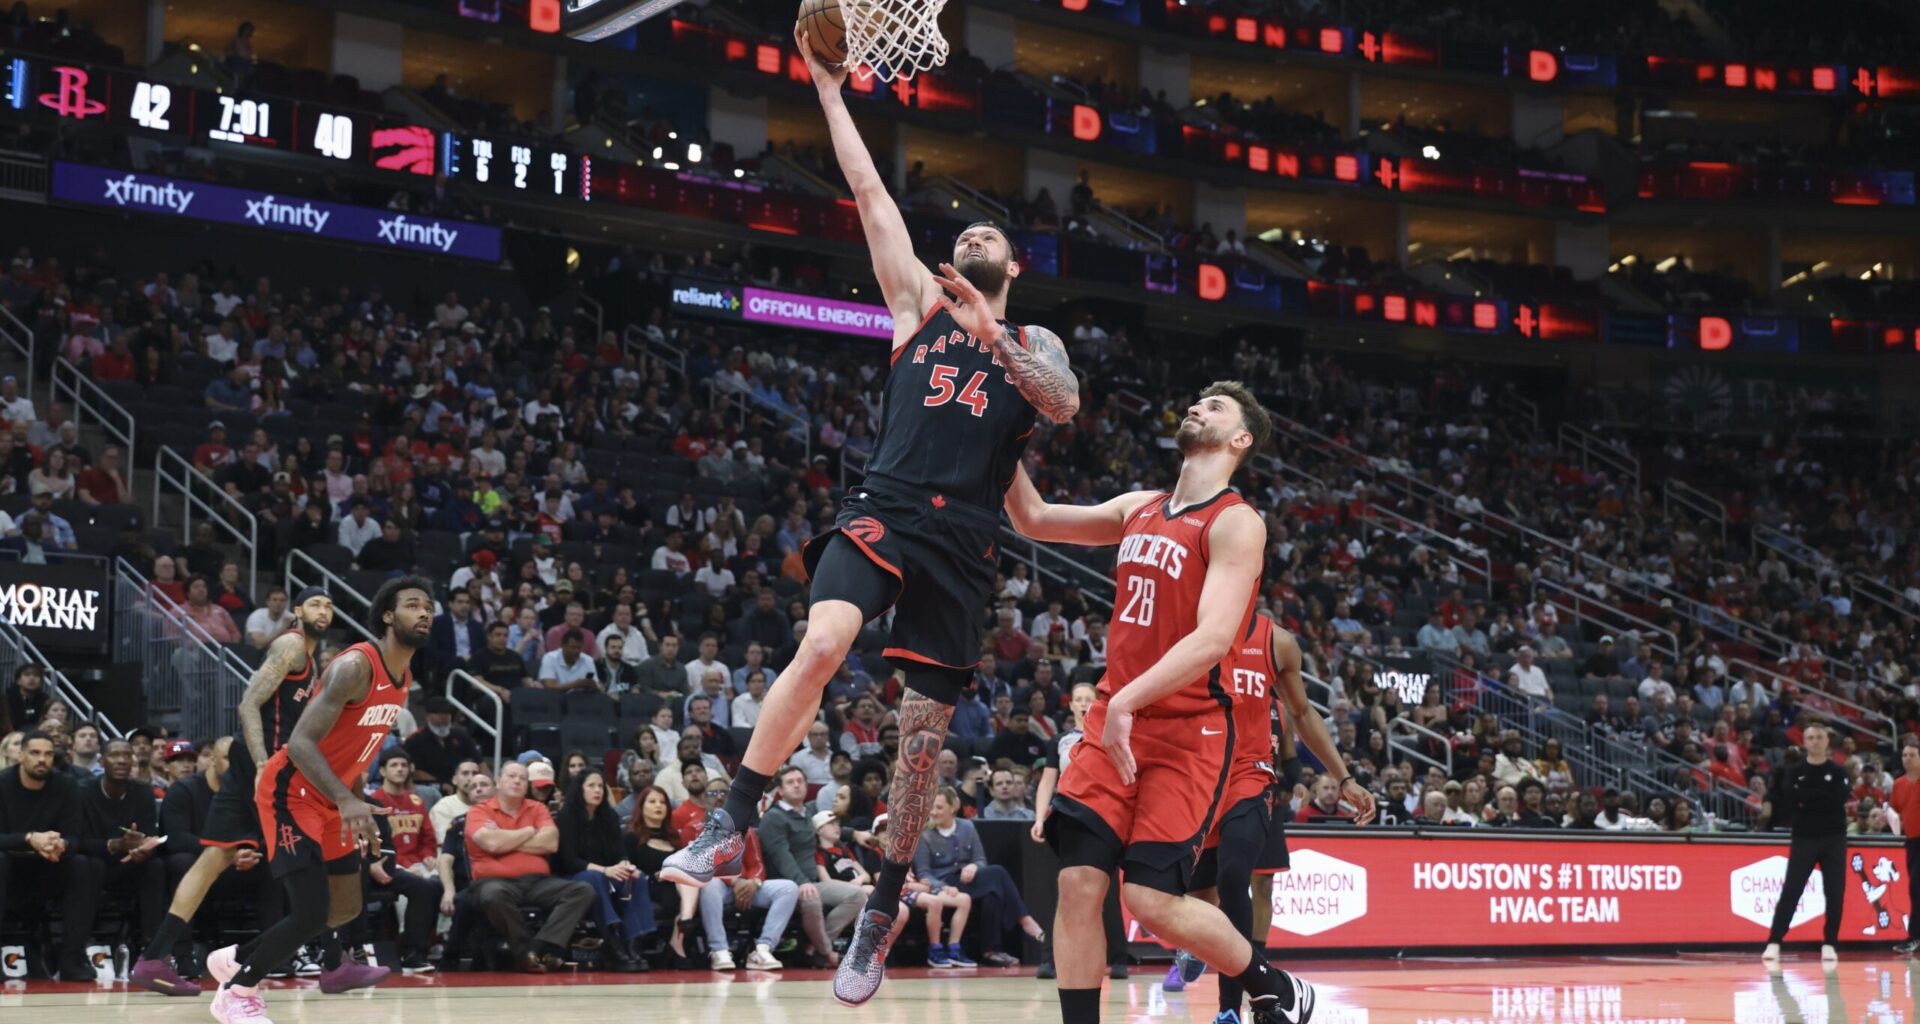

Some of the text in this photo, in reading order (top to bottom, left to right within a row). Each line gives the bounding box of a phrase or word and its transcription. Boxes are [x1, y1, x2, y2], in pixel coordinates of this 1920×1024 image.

[1529, 50, 1557, 81] D
[130, 81, 171, 130] 42
[218, 96, 269, 137] 7:01
[1073, 104, 1101, 140] D
[314, 112, 353, 160] 40
[511, 145, 531, 165] FLS
[476, 157, 563, 195] 5 2 1
[104, 174, 458, 251] xfinity xfinity xfinity
[1199, 263, 1227, 300] D
[673, 288, 722, 308] reliant
[750, 297, 814, 320] OFFICIAL
[818, 306, 874, 327] ENERGY
[1700, 317, 1732, 350] D
[924, 364, 989, 417] 54
[1119, 575, 1156, 627] 28
[356, 733, 384, 762] 17
[1413, 862, 1682, 891] HOUSTON'S #1 TRUSTED
[1273, 896, 1339, 915] & NASH
[1490, 896, 1620, 923] HVAC TEAM
[1754, 896, 1764, 913] &
